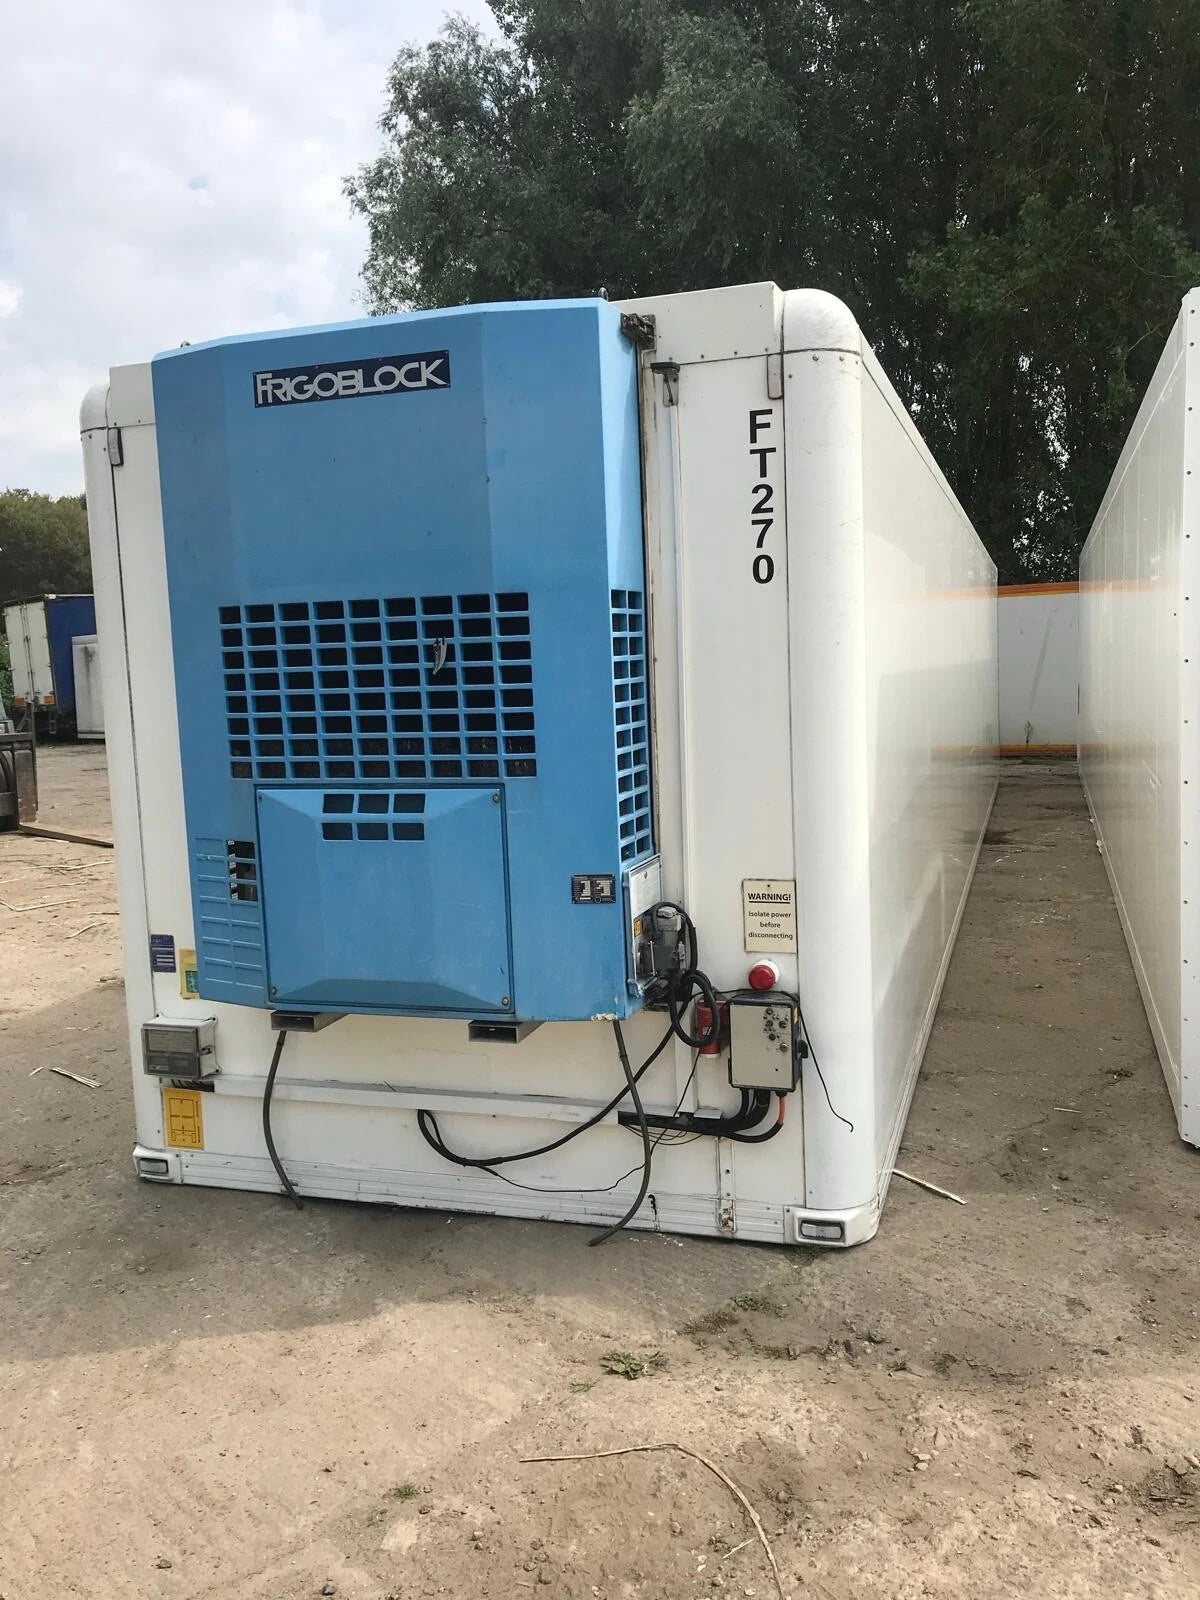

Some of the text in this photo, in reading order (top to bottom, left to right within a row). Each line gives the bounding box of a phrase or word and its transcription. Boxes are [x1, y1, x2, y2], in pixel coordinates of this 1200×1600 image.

[256, 358, 448, 404] FRIGOBLOCK
[749, 409, 776, 584] FT270
[748, 893, 791, 901] WARNING!
[748, 932, 793, 940] disconnecting
